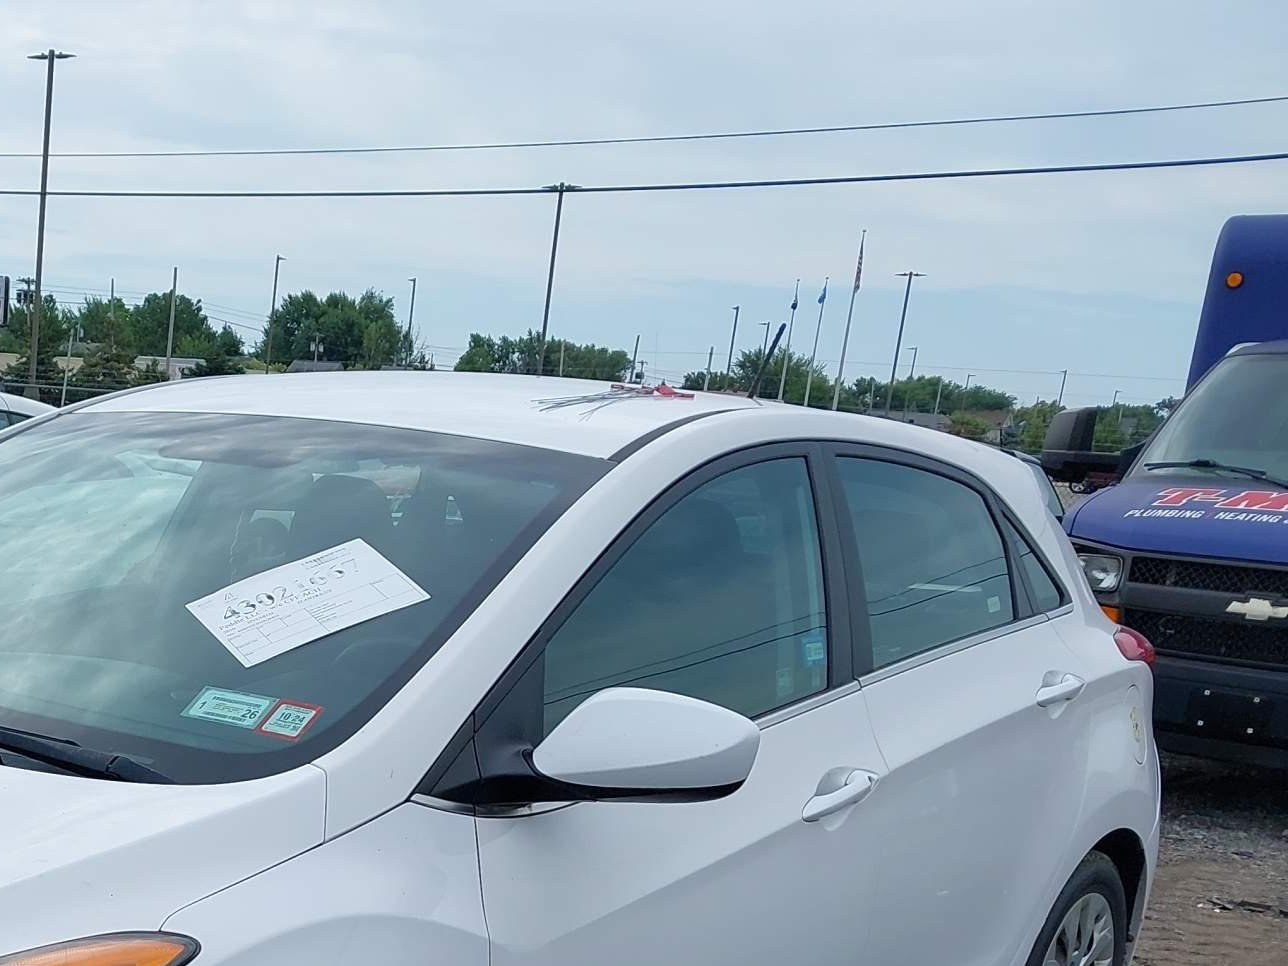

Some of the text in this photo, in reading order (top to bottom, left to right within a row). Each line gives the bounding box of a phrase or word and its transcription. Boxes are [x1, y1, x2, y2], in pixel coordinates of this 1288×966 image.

[1123, 508, 1205, 519] PLUMBING
[1214, 511, 1282, 523] HEATING
[241, 708, 260, 720] 26
